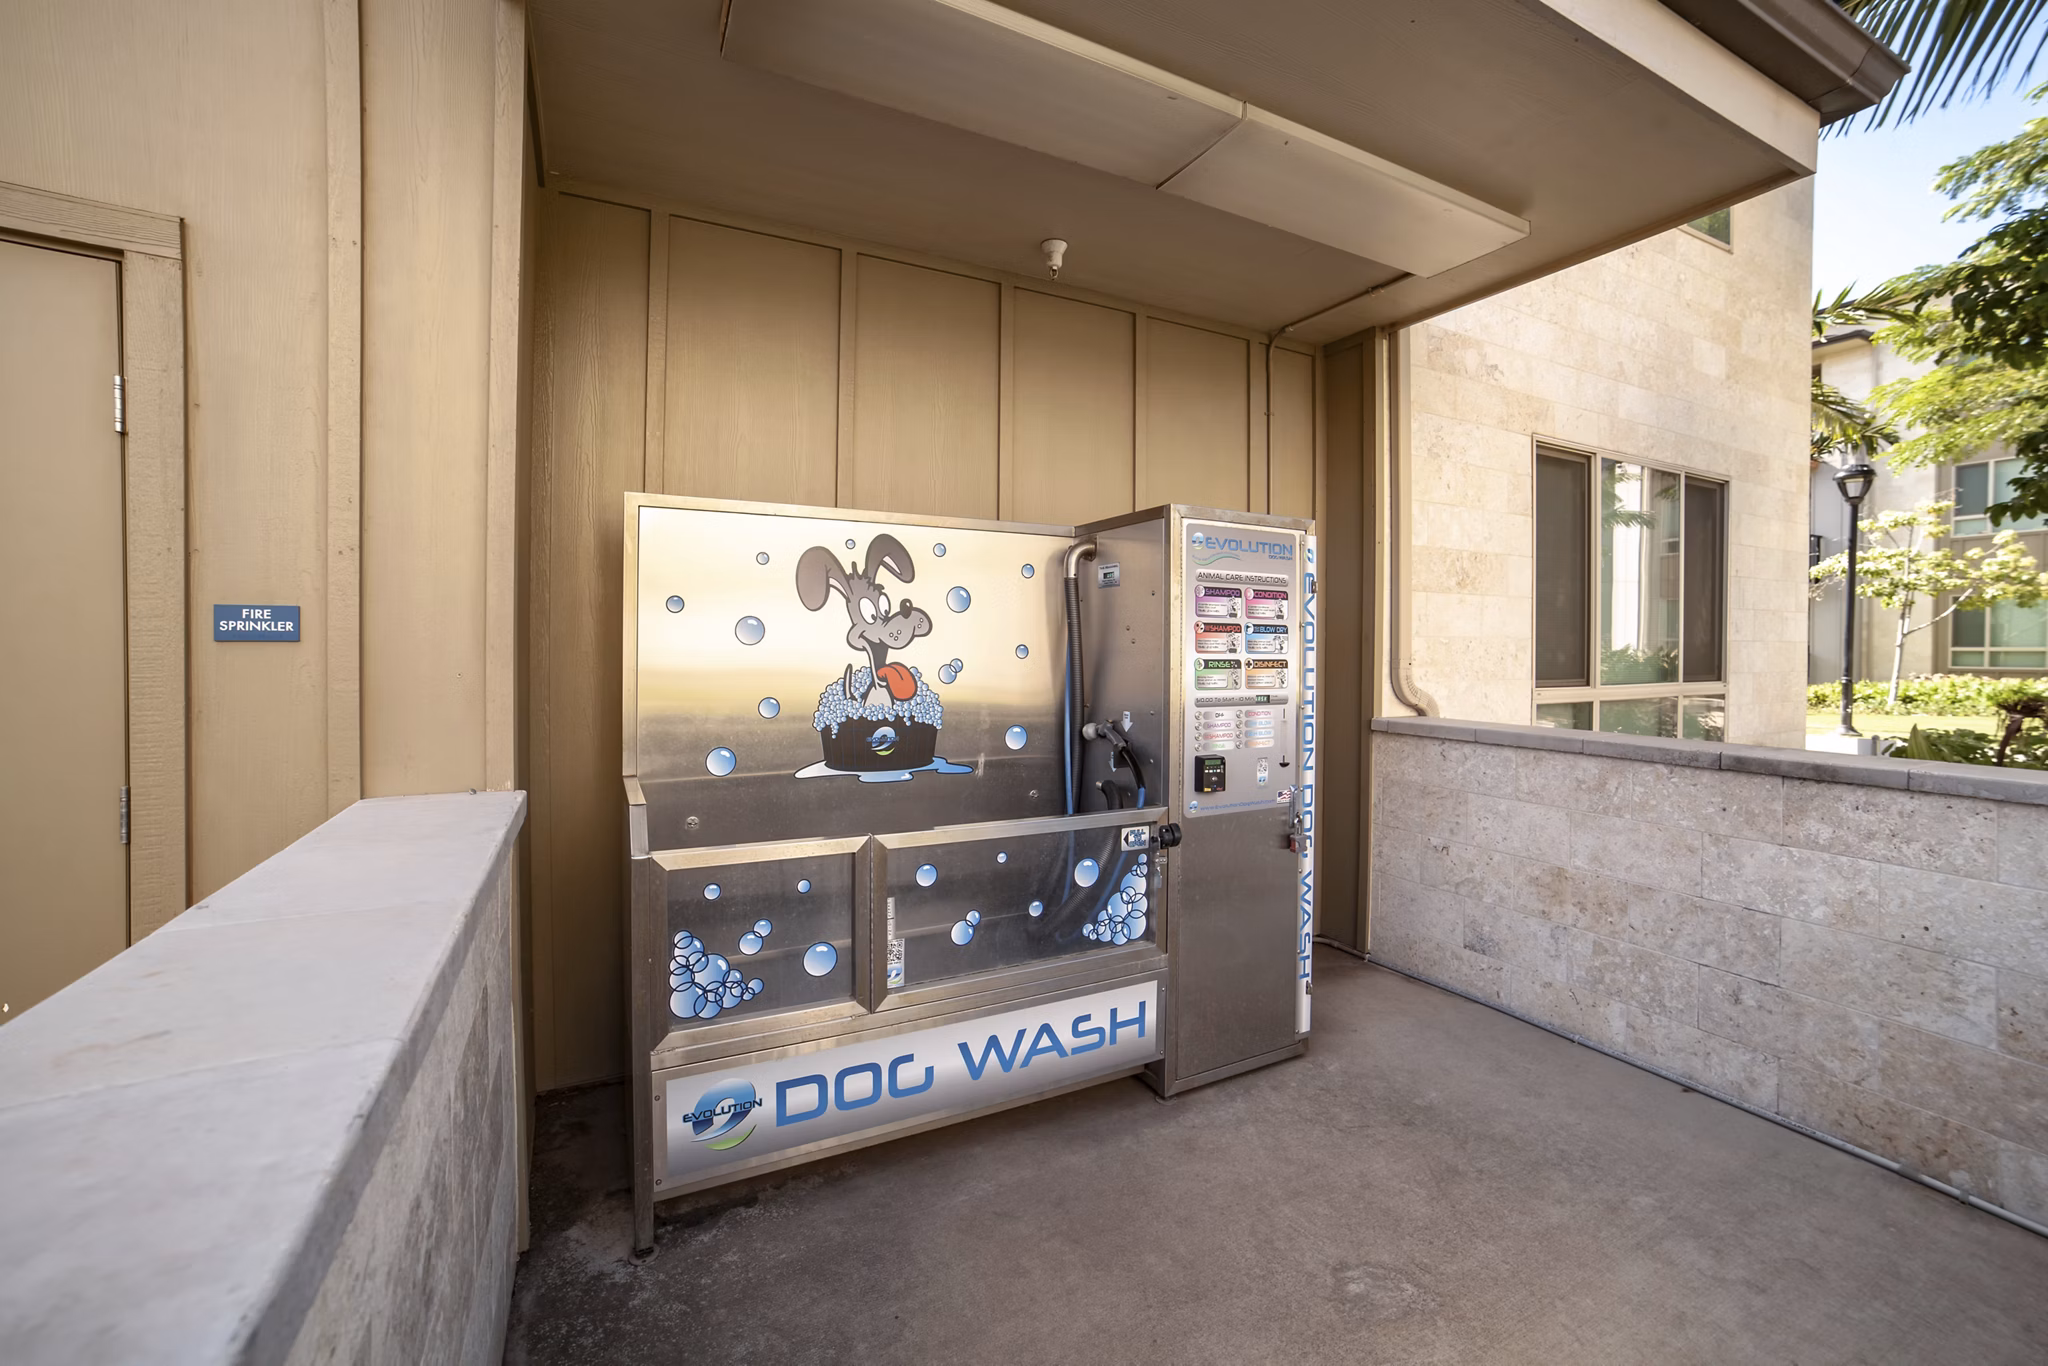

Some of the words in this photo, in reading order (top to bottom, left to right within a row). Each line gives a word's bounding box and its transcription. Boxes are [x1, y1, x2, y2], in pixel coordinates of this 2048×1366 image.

[1205, 536, 1293, 556] EVOLUTION
[1197, 572, 1225, 580] ANIMAL
[1225, 573, 1243, 581] CARE
[1244, 574, 1287, 584] INSTRUCTIONS
[1205, 588, 1240, 597] SHAMPOO
[1254, 590, 1287, 599] CONDITION
[242, 608, 272, 619] FIRE
[219, 620, 294, 632] SPRINKLER
[1210, 624, 1241, 633] SHAMPOO
[1302, 572, 1315, 771] EVOLUTION
[1298, 870, 1312, 980] WASH
[776, 1053, 935, 1127] DOG
[957, 1000, 1147, 1081] WASH
[682, 1098, 763, 1124] EVOLUTION
